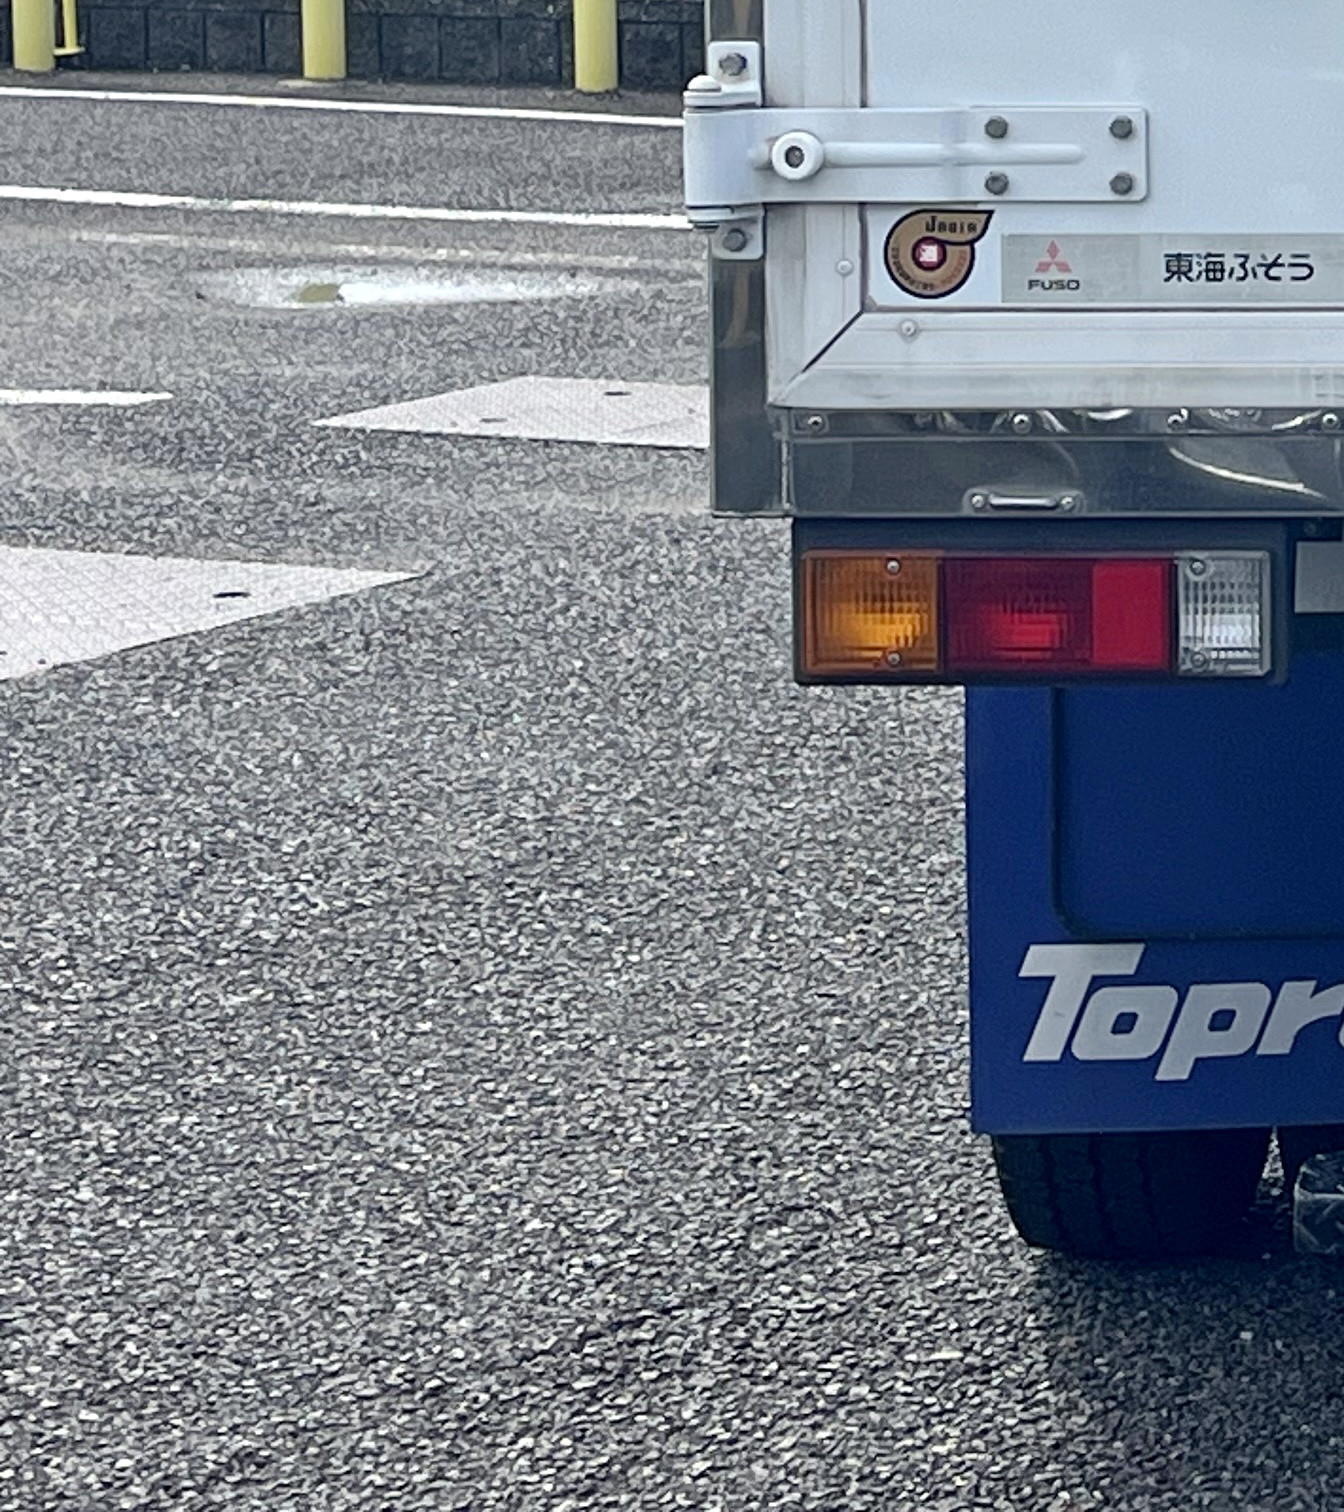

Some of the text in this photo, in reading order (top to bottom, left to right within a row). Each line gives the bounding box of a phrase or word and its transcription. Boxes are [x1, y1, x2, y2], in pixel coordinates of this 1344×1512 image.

[1163, 252, 1315, 283] 東海ふそう
[1027, 279, 1080, 291] FUSO
